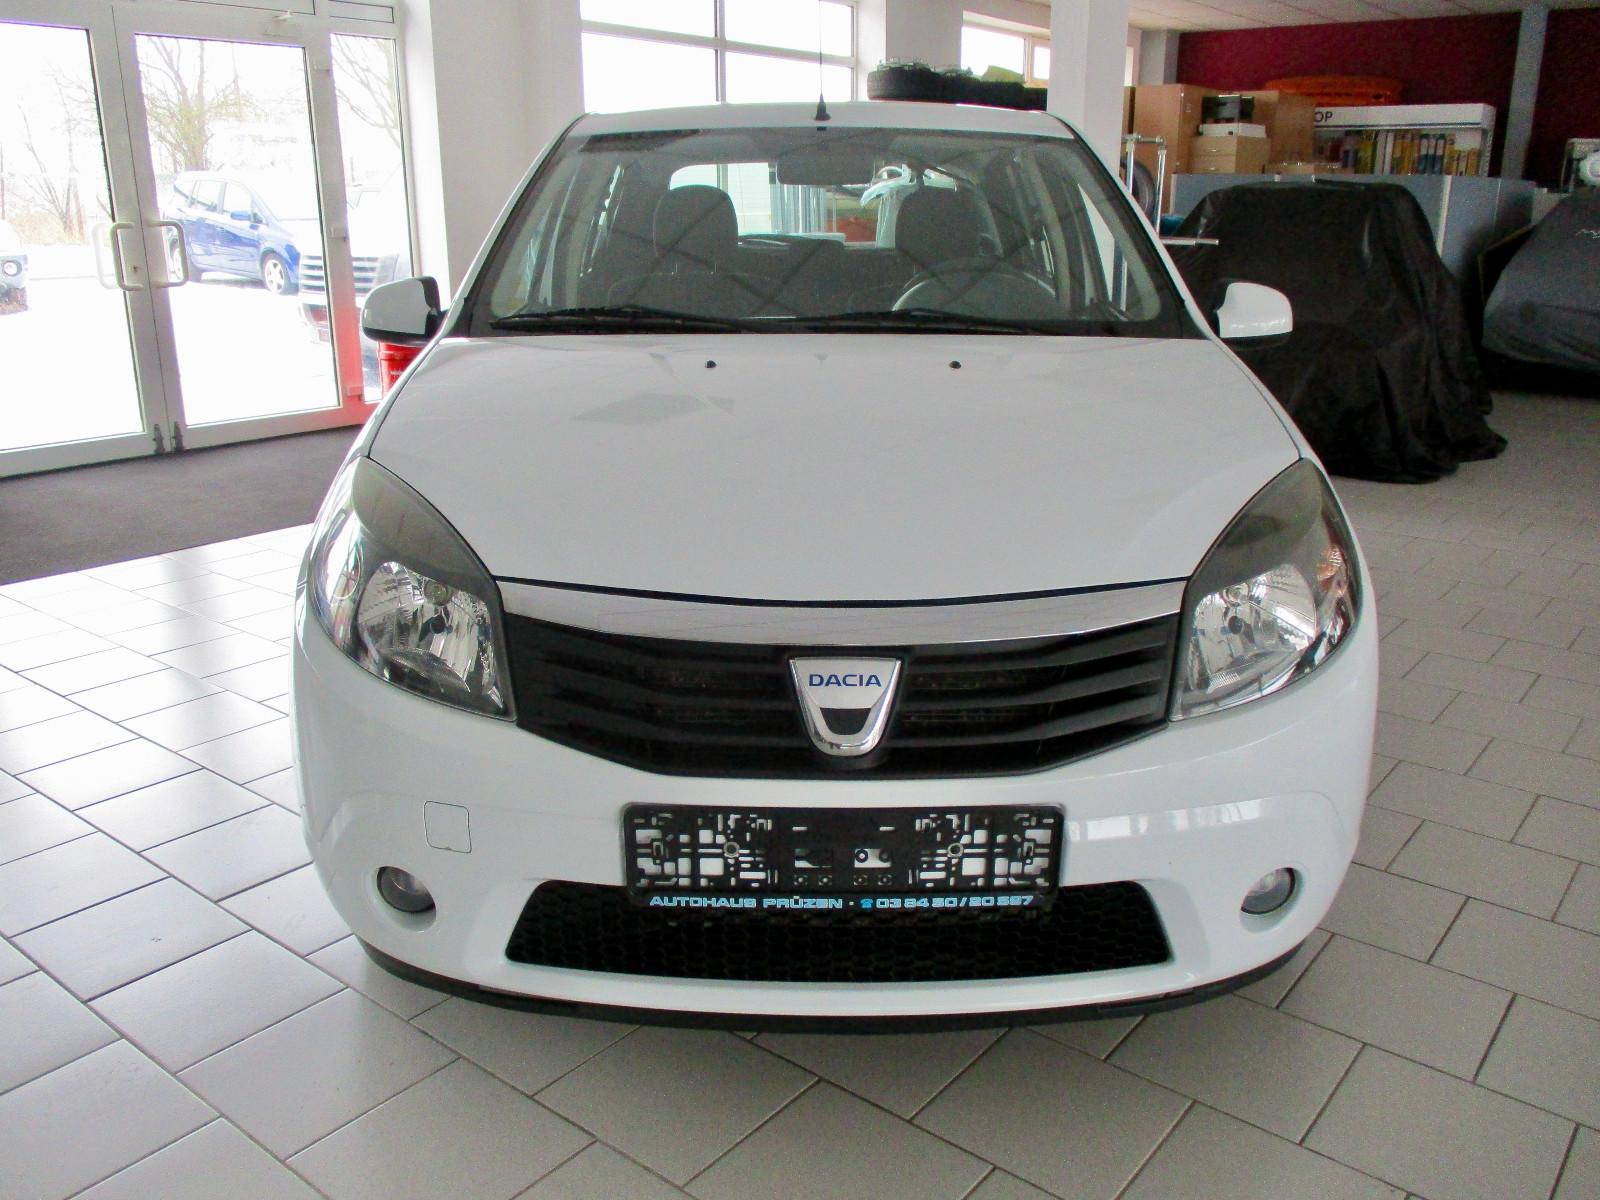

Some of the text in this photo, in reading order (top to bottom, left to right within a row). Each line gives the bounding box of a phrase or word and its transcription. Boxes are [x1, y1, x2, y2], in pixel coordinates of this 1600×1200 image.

[808, 674, 882, 687] DACIA
[650, 896, 756, 908] AUTOHAUS
[763, 896, 842, 909] PRÜZEN
